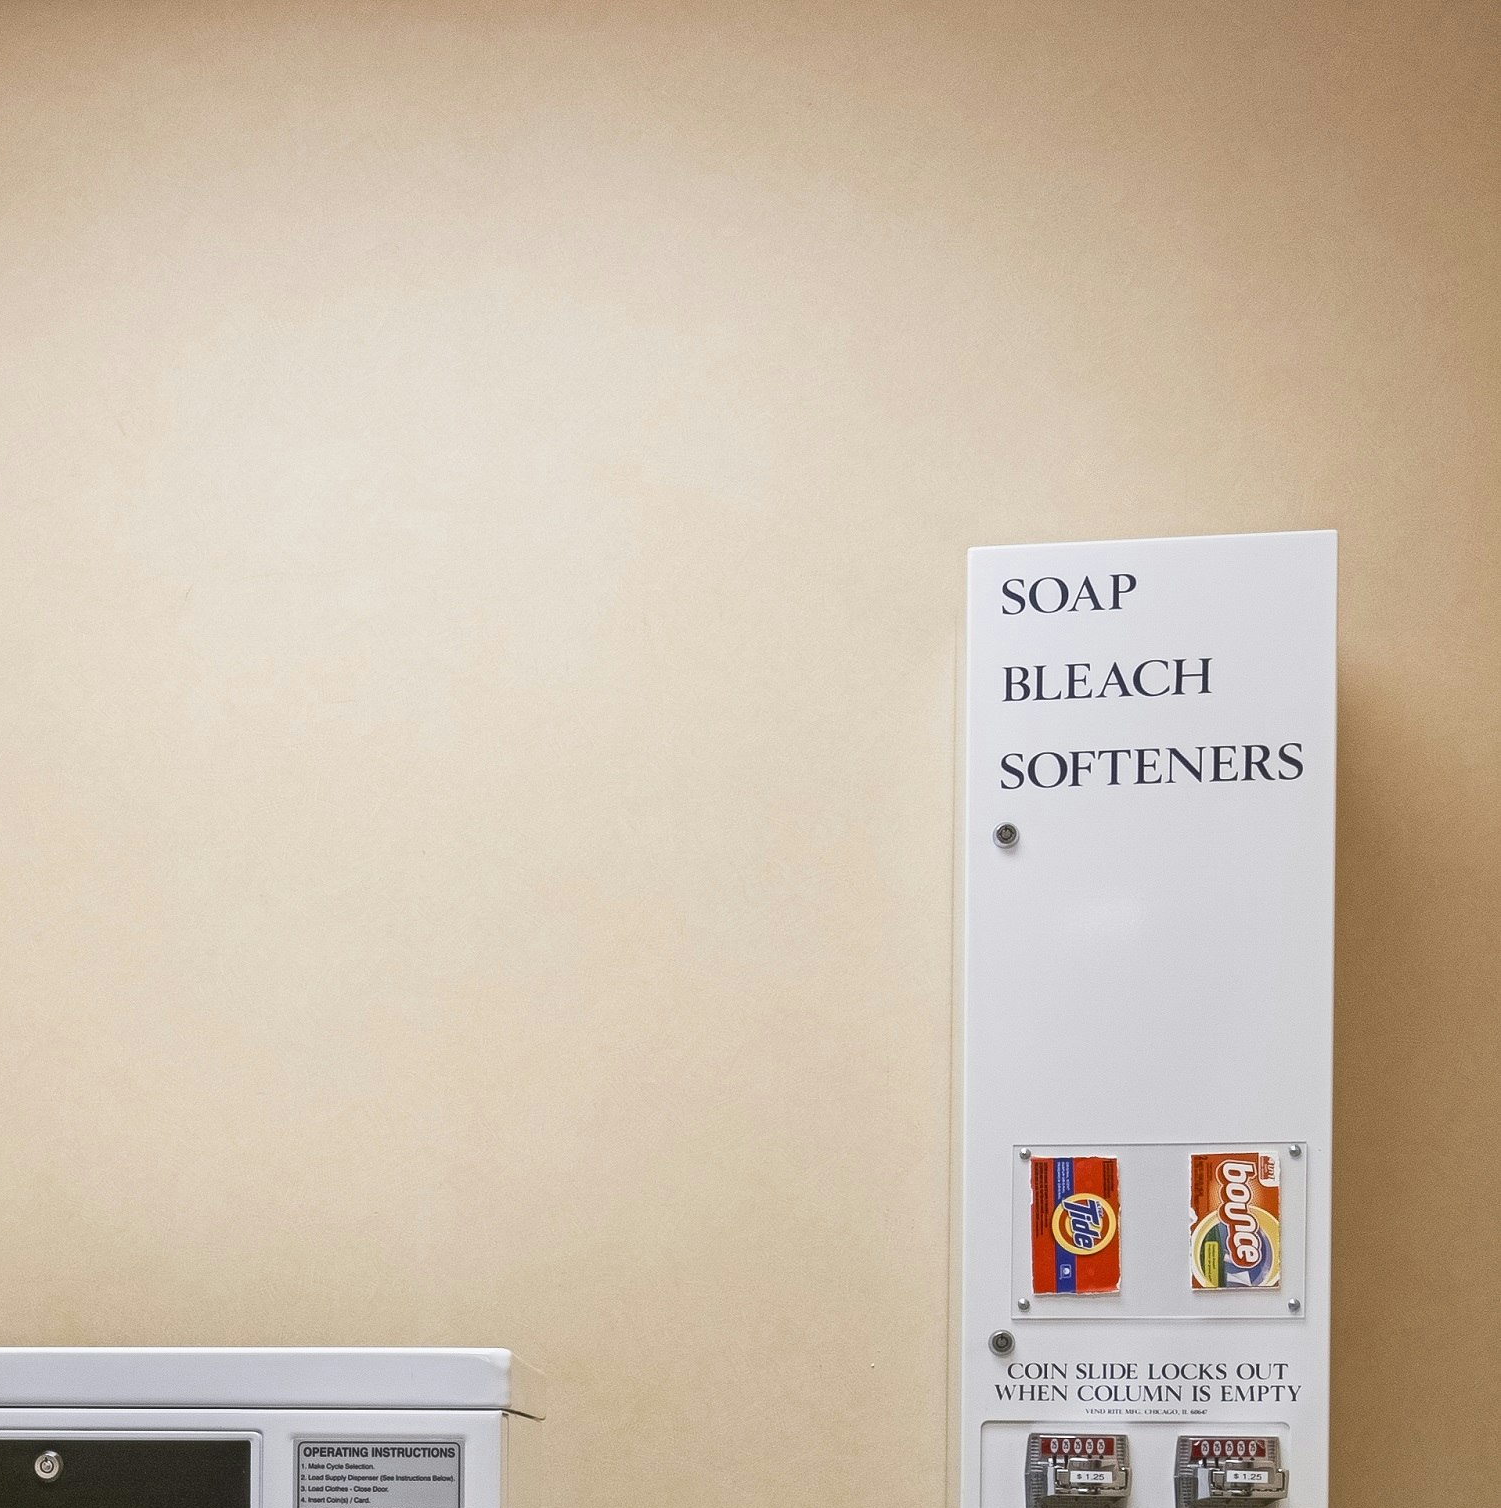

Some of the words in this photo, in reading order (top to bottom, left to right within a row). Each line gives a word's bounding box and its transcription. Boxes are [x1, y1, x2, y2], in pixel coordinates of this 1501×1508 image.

[1001, 573, 1137, 615] SOAP
[1002, 658, 1213, 702] BLEACH
[1000, 743, 1304, 789] SOFTENERS
[1062, 1199, 1102, 1250] Tide
[1222, 1161, 1261, 1266] bounce
[1006, 1362, 1068, 1380] COIN
[1075, 1362, 1138, 1380] SLIDE
[1148, 1363, 1227, 1380] LOCKS
[1236, 1363, 1289, 1380] OUT
[994, 1384, 1068, 1402] WHEN
[1077, 1384, 1183, 1402] COLUMN
[1192, 1385, 1211, 1402] IS
[1221, 1385, 1302, 1402] EMPTY
[303, 1447, 369, 1458] OPERATING
[371, 1447, 456, 1458] INSTRUCTIONS
